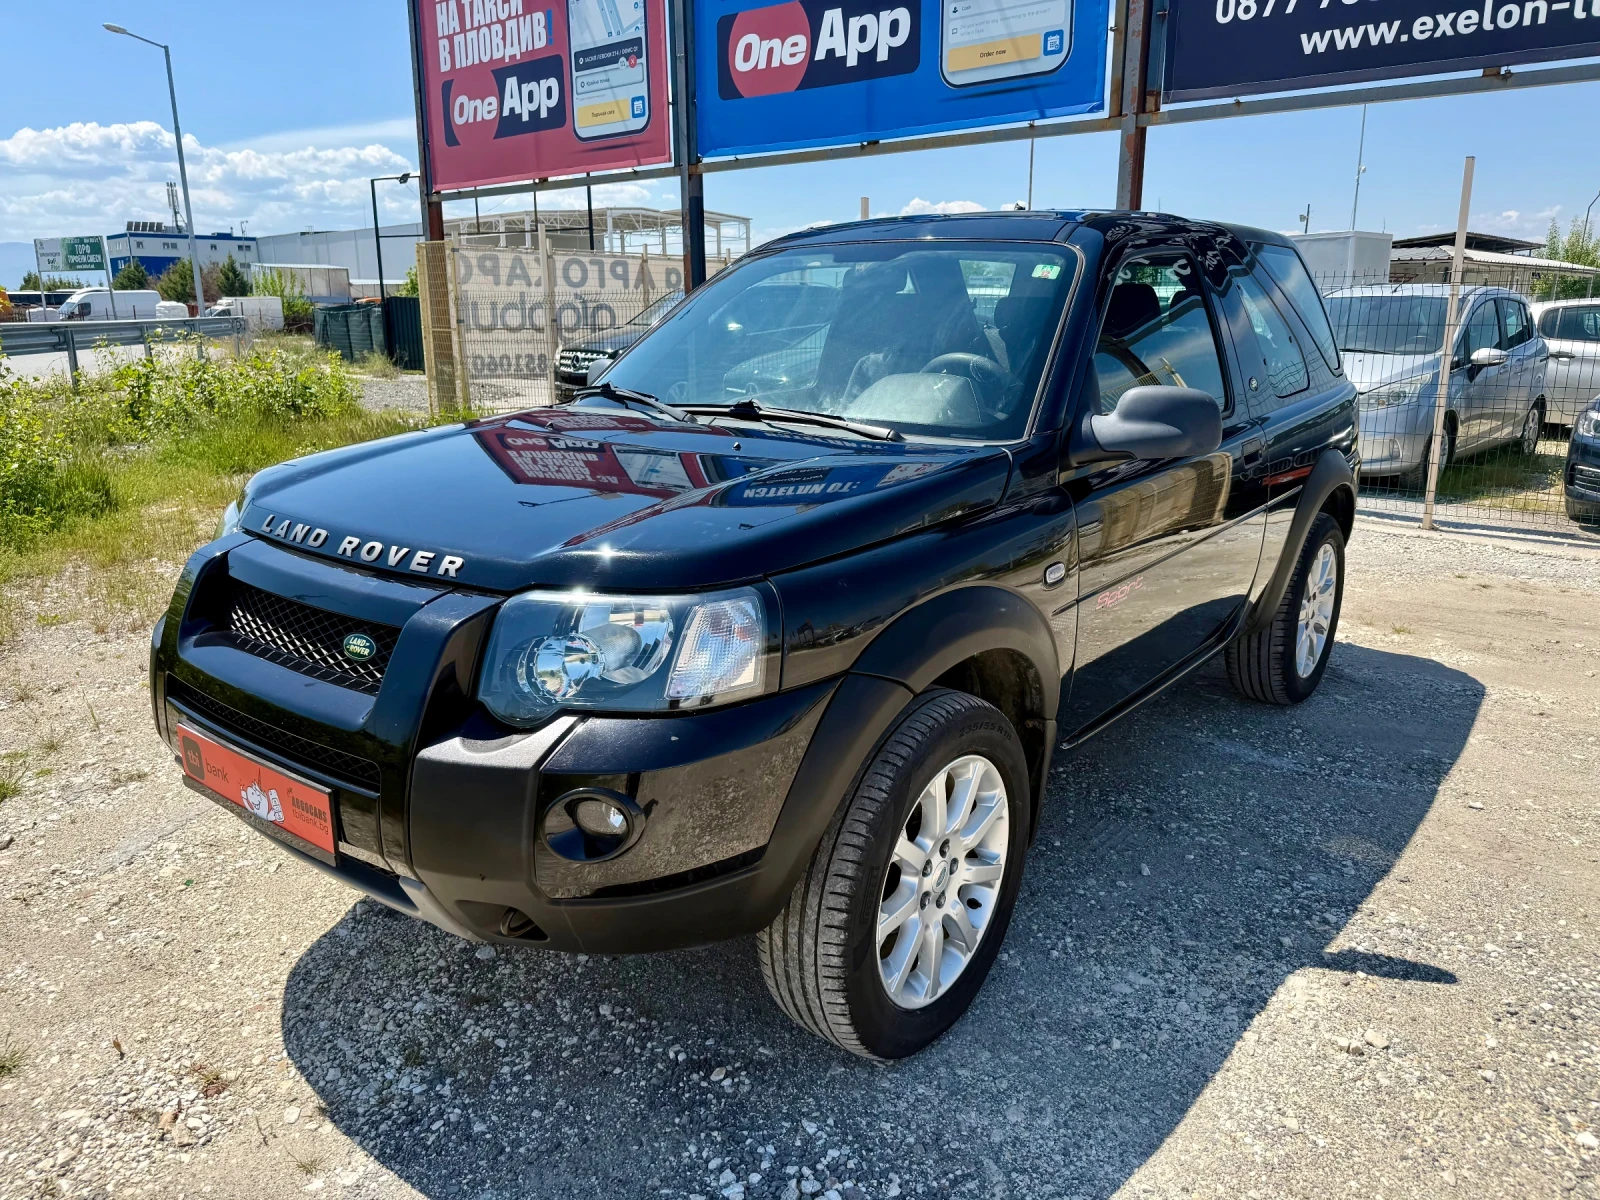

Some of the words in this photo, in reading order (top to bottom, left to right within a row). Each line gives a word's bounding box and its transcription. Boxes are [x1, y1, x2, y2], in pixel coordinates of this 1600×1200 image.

[436, 1, 460, 37] НА
[438, 38, 451, 73] В
[454, 8, 553, 69] ПЛОВДИВ!
[735, 33, 807, 72] One
[814, 7, 911, 67] App
[454, 95, 497, 125] One
[503, 75, 559, 122] App
[75, 244, 91, 255] ТОРФ
[261, 514, 329, 548] LAND
[337, 535, 465, 578] ROVER
[349, 636, 367, 647] LAND
[349, 644, 370, 656] ROVER
[187, 749, 200, 767] tbi
[205, 757, 229, 783] bank
[292, 795, 328, 823] ARGOCARS
[292, 808, 329, 836] tbibank.bg
